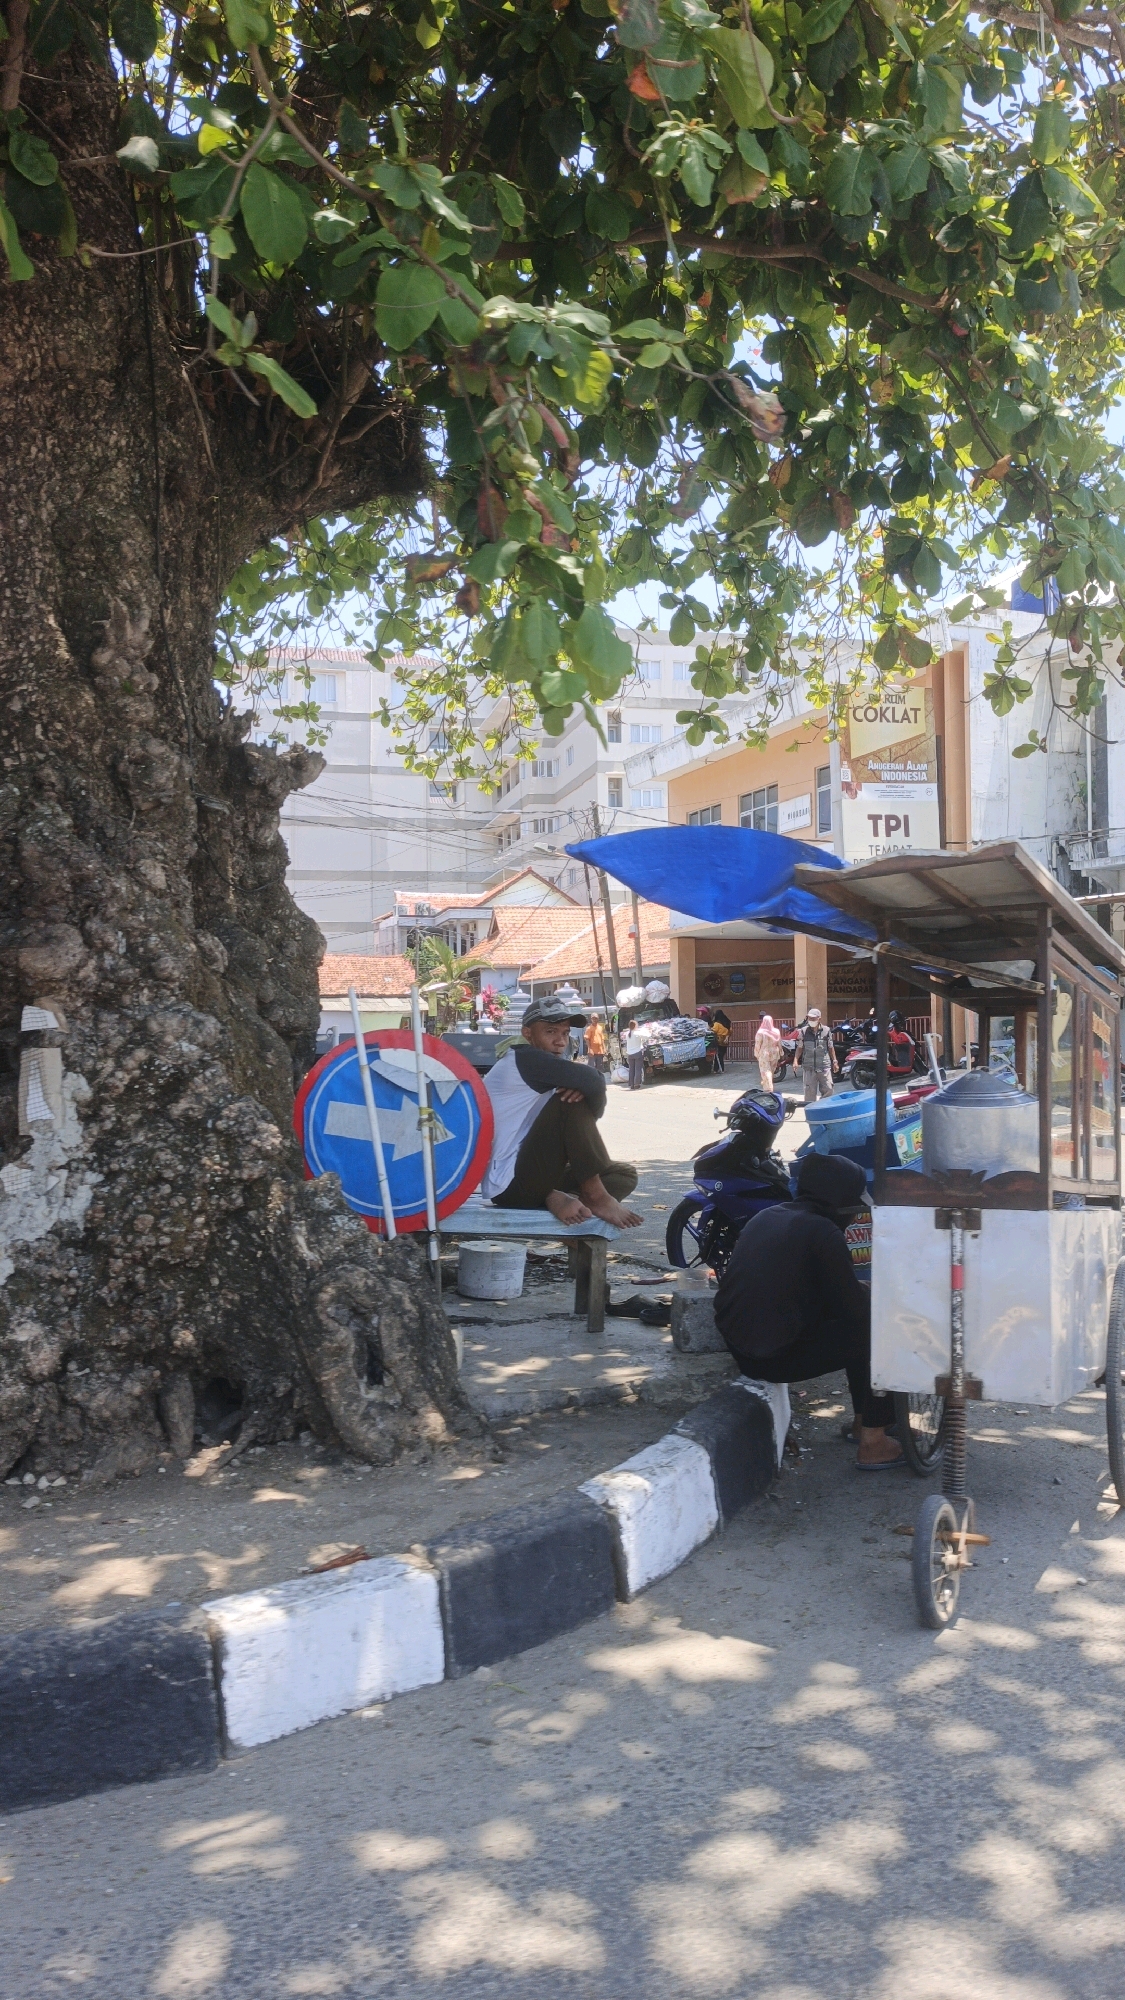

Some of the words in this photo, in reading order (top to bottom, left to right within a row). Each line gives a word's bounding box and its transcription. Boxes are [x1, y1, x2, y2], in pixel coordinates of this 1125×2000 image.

[852, 706, 921, 724] COKLAT
[868, 760, 904, 770] ANUGERAH
[906, 761, 928, 771] ALAM
[881, 771, 928, 781] INDONESIA
[867, 814, 910, 838] TPI
